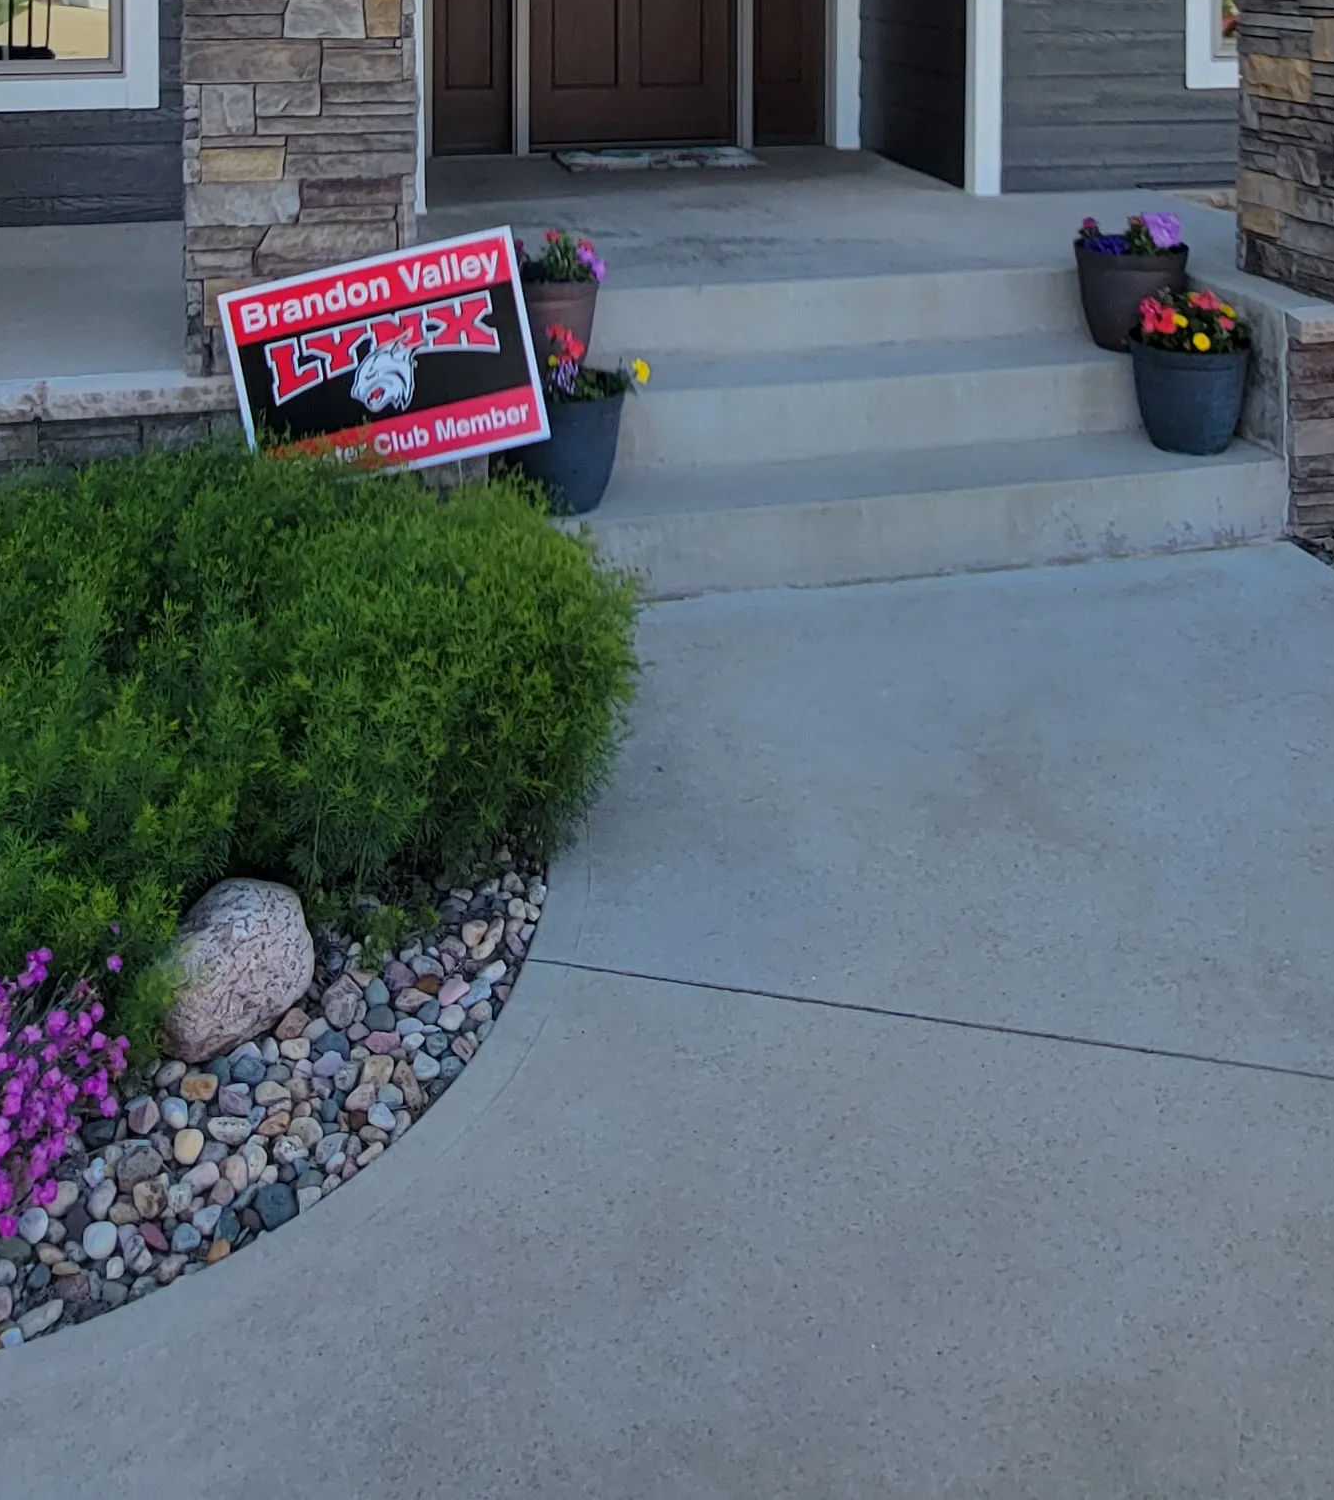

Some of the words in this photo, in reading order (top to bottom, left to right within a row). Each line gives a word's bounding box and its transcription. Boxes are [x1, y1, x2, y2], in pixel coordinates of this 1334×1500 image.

[240, 276, 390, 334] Brandon
[398, 250, 499, 293] Valley
[264, 289, 501, 407] LYNX
[373, 424, 430, 457] Club
[434, 402, 529, 443] Member
